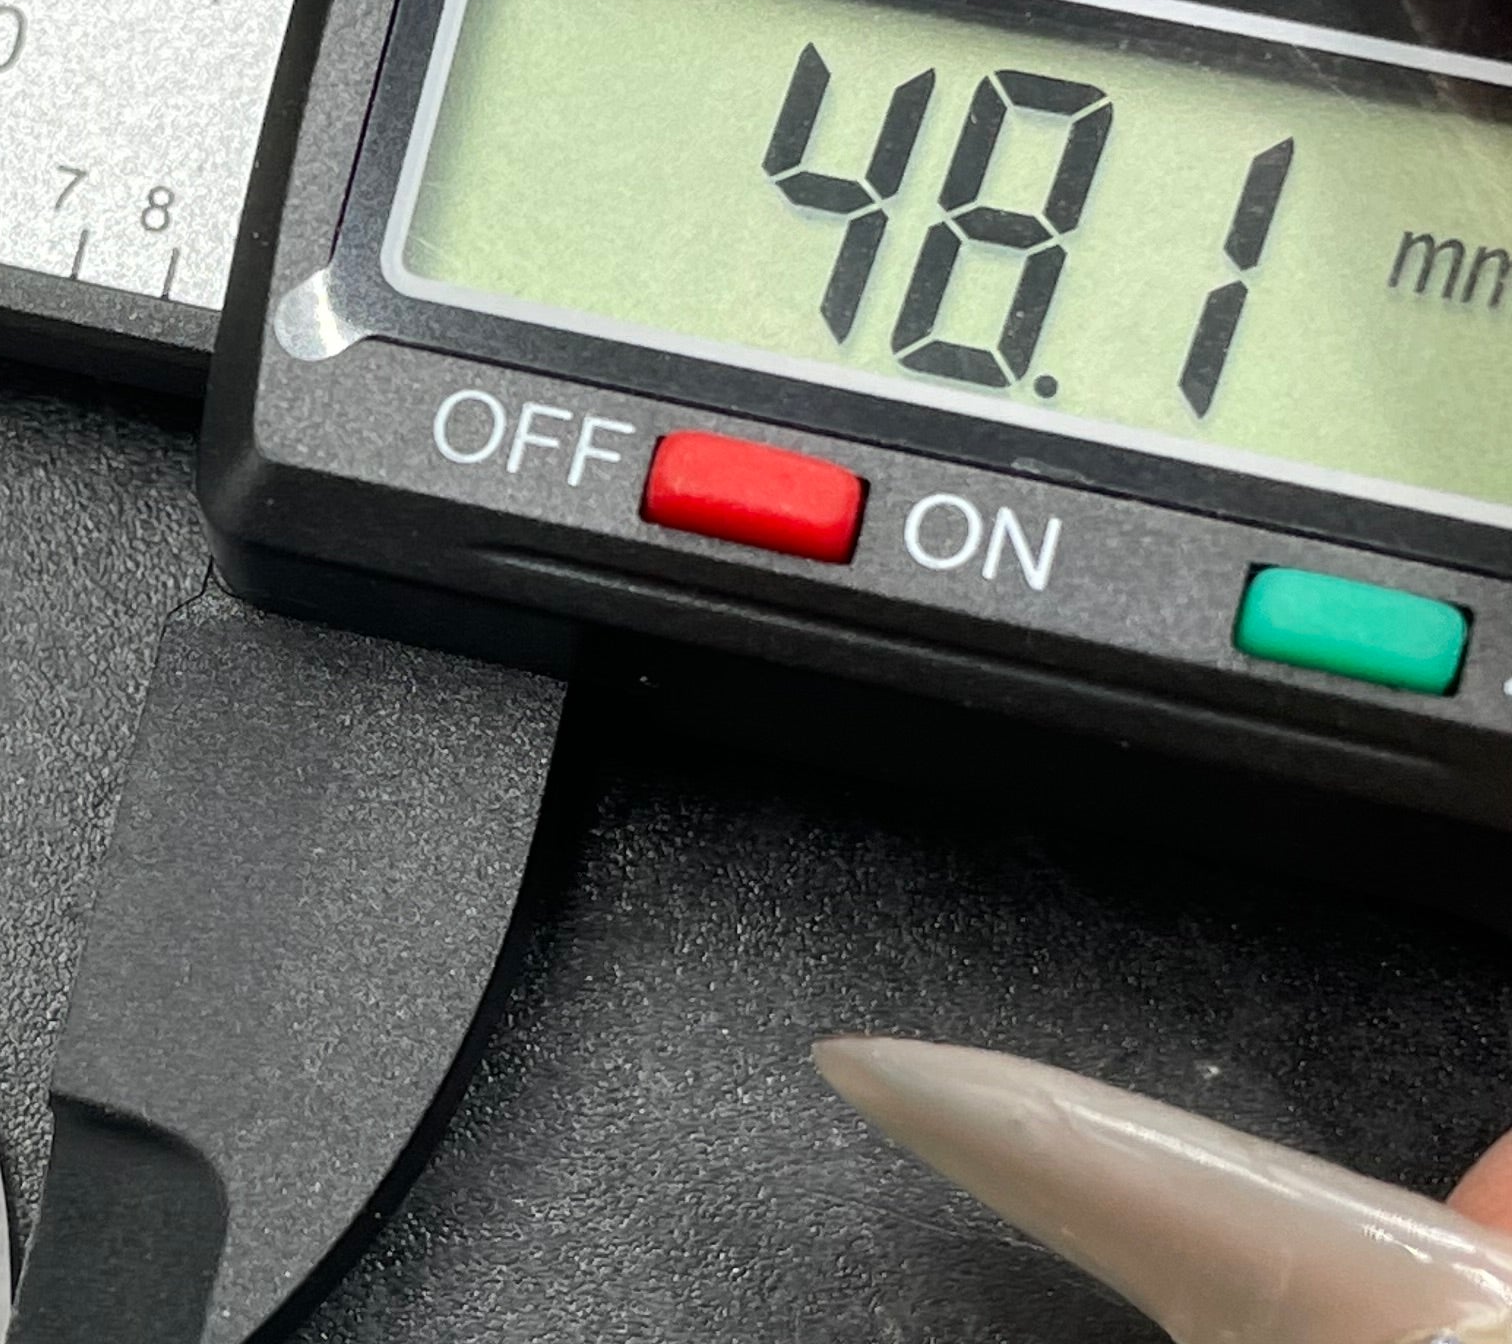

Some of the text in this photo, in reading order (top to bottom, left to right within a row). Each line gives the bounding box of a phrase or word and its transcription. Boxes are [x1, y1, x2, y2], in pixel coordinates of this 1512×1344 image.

[54, 167, 87, 213] 7
[140, 187, 175, 233] 8
[762, 41, 1294, 419] 48.1
[433, 388, 636, 489] OFF
[902, 491, 1064, 592] ON
